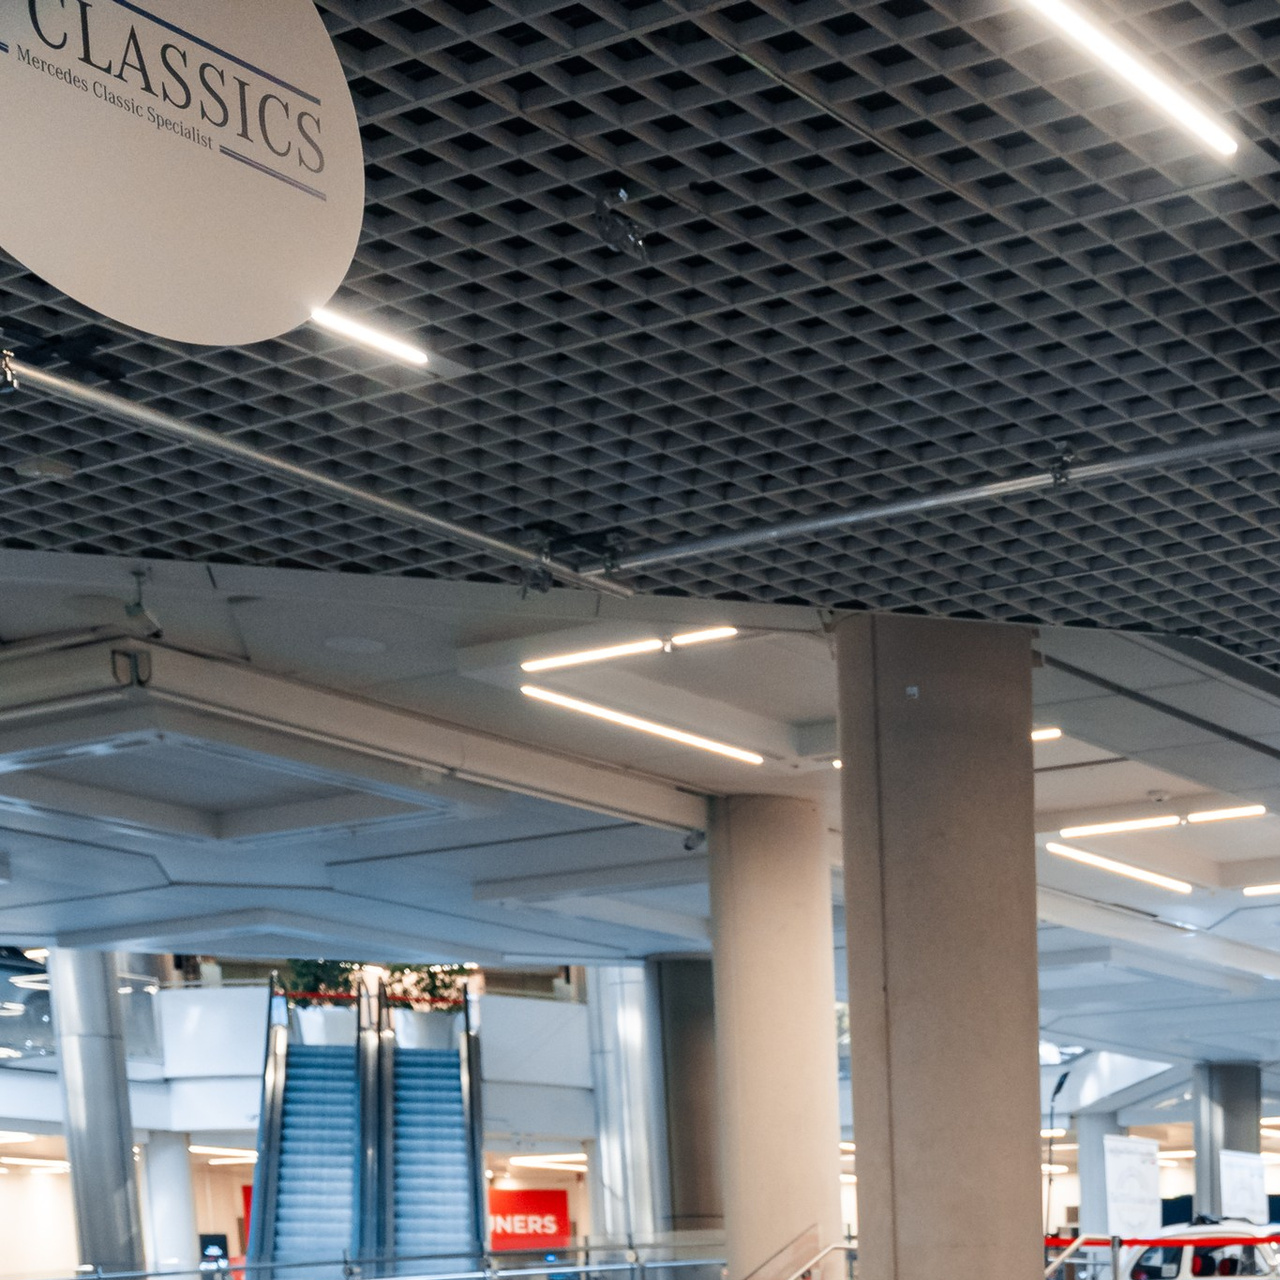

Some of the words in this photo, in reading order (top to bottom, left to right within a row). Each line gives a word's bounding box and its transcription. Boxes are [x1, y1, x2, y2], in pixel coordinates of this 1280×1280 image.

[16, 44, 89, 92] Mercedes
[92, 80, 144, 118] Classic
[147, 106, 214, 150] Specialist
[27, 0, 325, 174] CLASSICS
